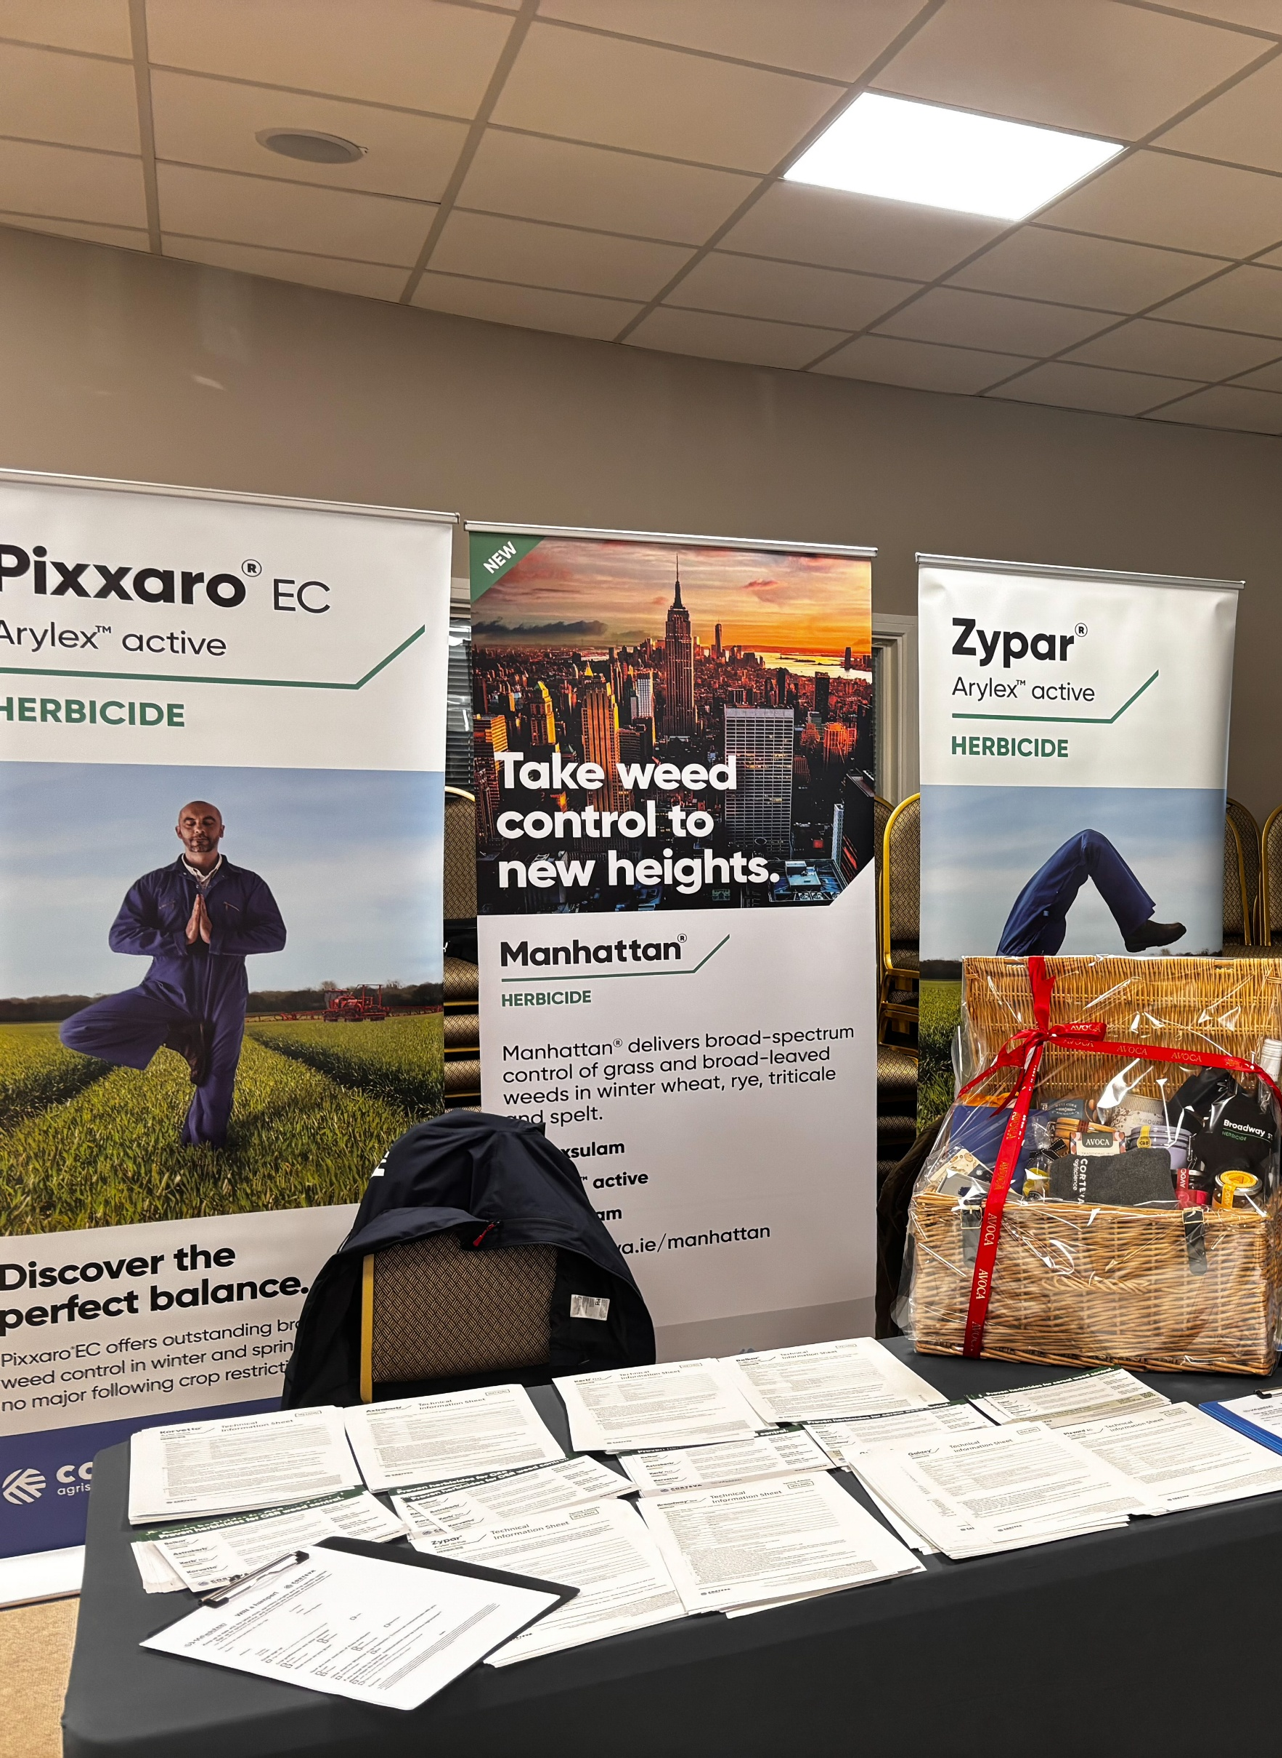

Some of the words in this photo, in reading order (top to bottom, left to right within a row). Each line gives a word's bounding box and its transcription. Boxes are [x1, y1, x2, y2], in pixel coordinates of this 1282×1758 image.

[483, 541, 517, 574] NEW
[272, 579, 331, 614] EC
[122, 630, 227, 656] active
[1031, 682, 1095, 702] active
[0, 697, 185, 727] HERBICIDE
[952, 736, 1069, 758] HERBICIDE
[494, 751, 604, 789] Take
[617, 755, 737, 789] weed
[496, 800, 655, 838] control
[668, 806, 714, 837] to
[499, 857, 595, 888] new
[608, 849, 780, 894] heights.
[501, 990, 591, 1007] HERBICIDE
[628, 1033, 700, 1054] delivers
[705, 1025, 854, 1049] broad-spectrum
[1117, 1045, 1148, 1056] AVOCA
[503, 1064, 573, 1084] control
[580, 1062, 599, 1078] of
[604, 1061, 654, 1081] grass
[660, 1055, 697, 1073] and
[702, 1046, 830, 1070] broad-leaved
[1171, 1052, 1202, 1062] AVOCA
[503, 1086, 569, 1105] weeds
[575, 1085, 591, 1101] in
[598, 1080, 656, 1099] winter
[661, 1075, 726, 1096] wheat,
[731, 1072, 763, 1091] rye,
[768, 1066, 836, 1086] triticale
[550, 1106, 603, 1127] spelt.
[1223, 1119, 1265, 1137] Broadway
[1085, 1138, 1110, 1146] AVOCA
[593, 1171, 649, 1189] active
[1078, 1158, 1088, 1204] CORTEVA
[984, 1213, 997, 1246] AVOCA
[0, 1254, 164, 1291] Discover
[173, 1244, 236, 1271] the
[976, 1268, 988, 1300] AVOCA
[0, 1290, 139, 1336] perfect
[150, 1276, 310, 1312] balance.
[106, 1336, 157, 1355] offers
[162, 1322, 272, 1347] outstanding
[1, 1370, 55, 1390] weed
[61, 1361, 125, 1383] control
[131, 1358, 146, 1372] in
[151, 1350, 207, 1370] winter
[211, 1344, 247, 1362] and
[252, 1339, 294, 1363] sprin
[1, 1399, 27, 1413] no
[31, 1389, 85, 1410] major
[91, 1377, 174, 1402] following
[179, 1371, 220, 1394] crop
[490, 1524, 530, 1534] Technical
[493, 1528, 544, 1540] Information
[545, 1521, 570, 1530] Sheet
